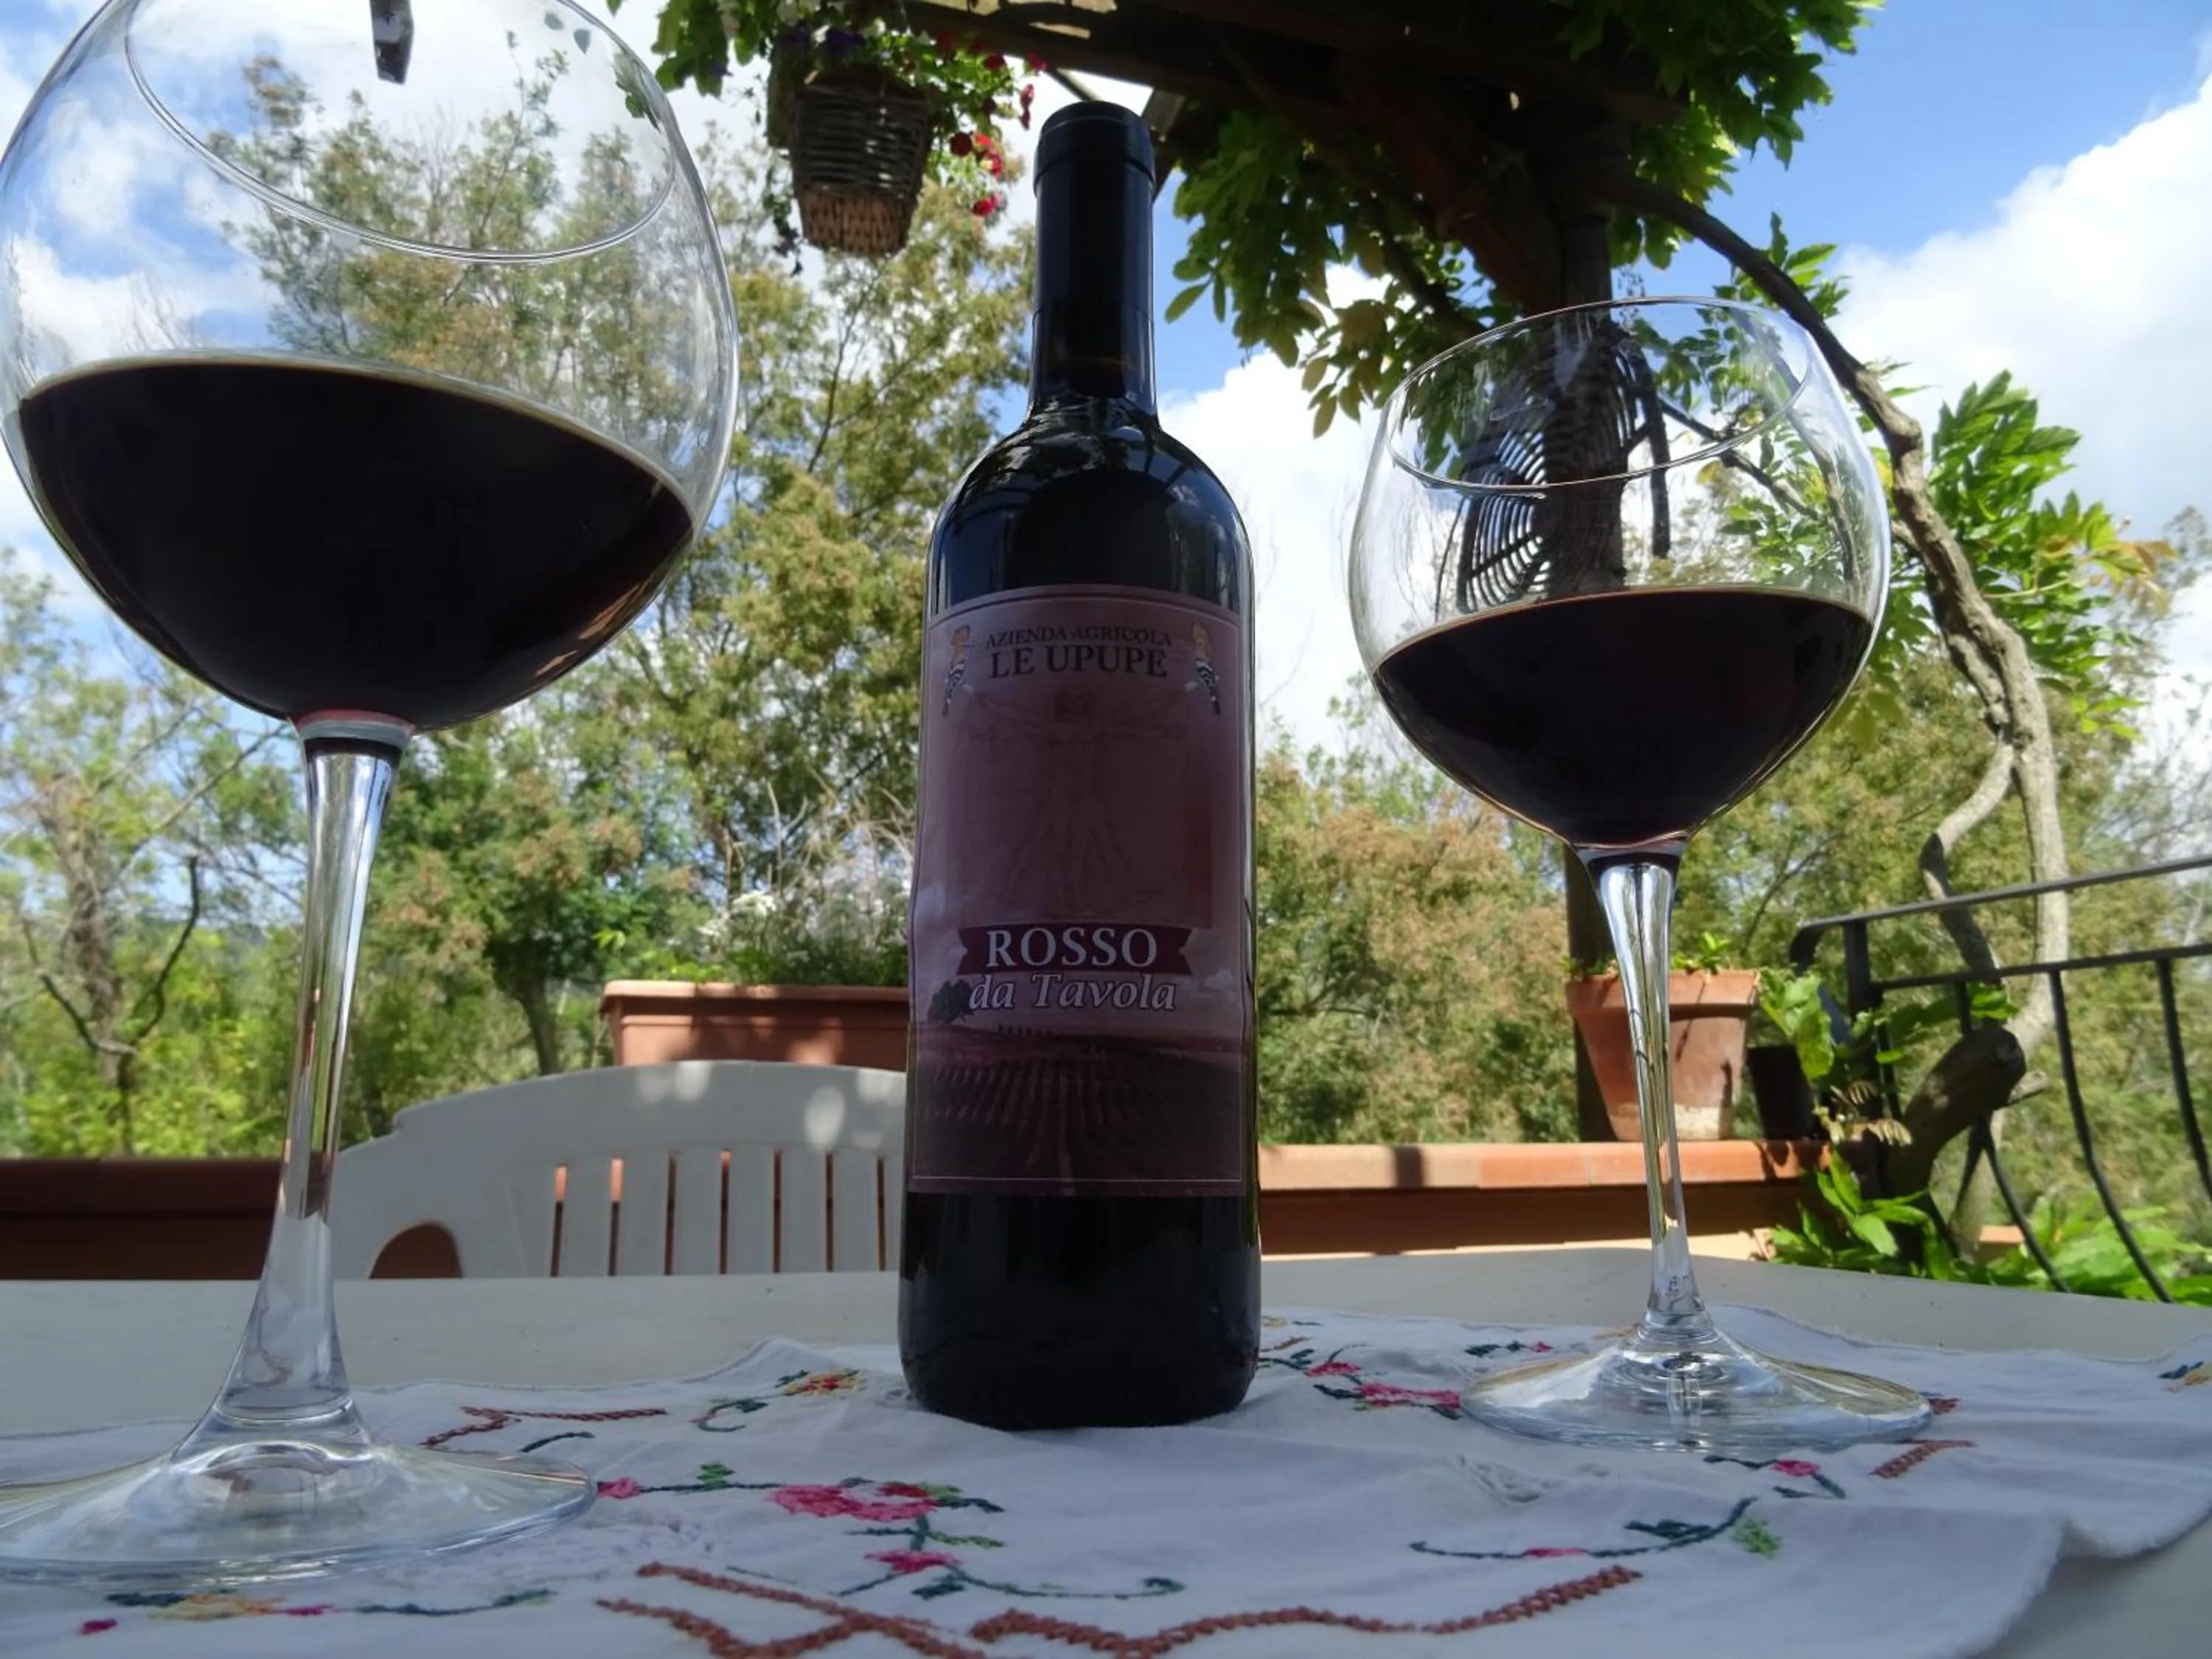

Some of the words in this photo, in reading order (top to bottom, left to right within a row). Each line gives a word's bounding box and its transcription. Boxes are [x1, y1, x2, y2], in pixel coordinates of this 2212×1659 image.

[986, 626, 1065, 647] AZIENDA
[1071, 625, 1172, 645] AGRICOLA
[990, 647, 1034, 678] LE
[1046, 645, 1168, 678] UPUPE
[985, 927, 1158, 967] ROSSO
[968, 975, 1015, 1009] da
[1032, 972, 1177, 1010] Tavola
